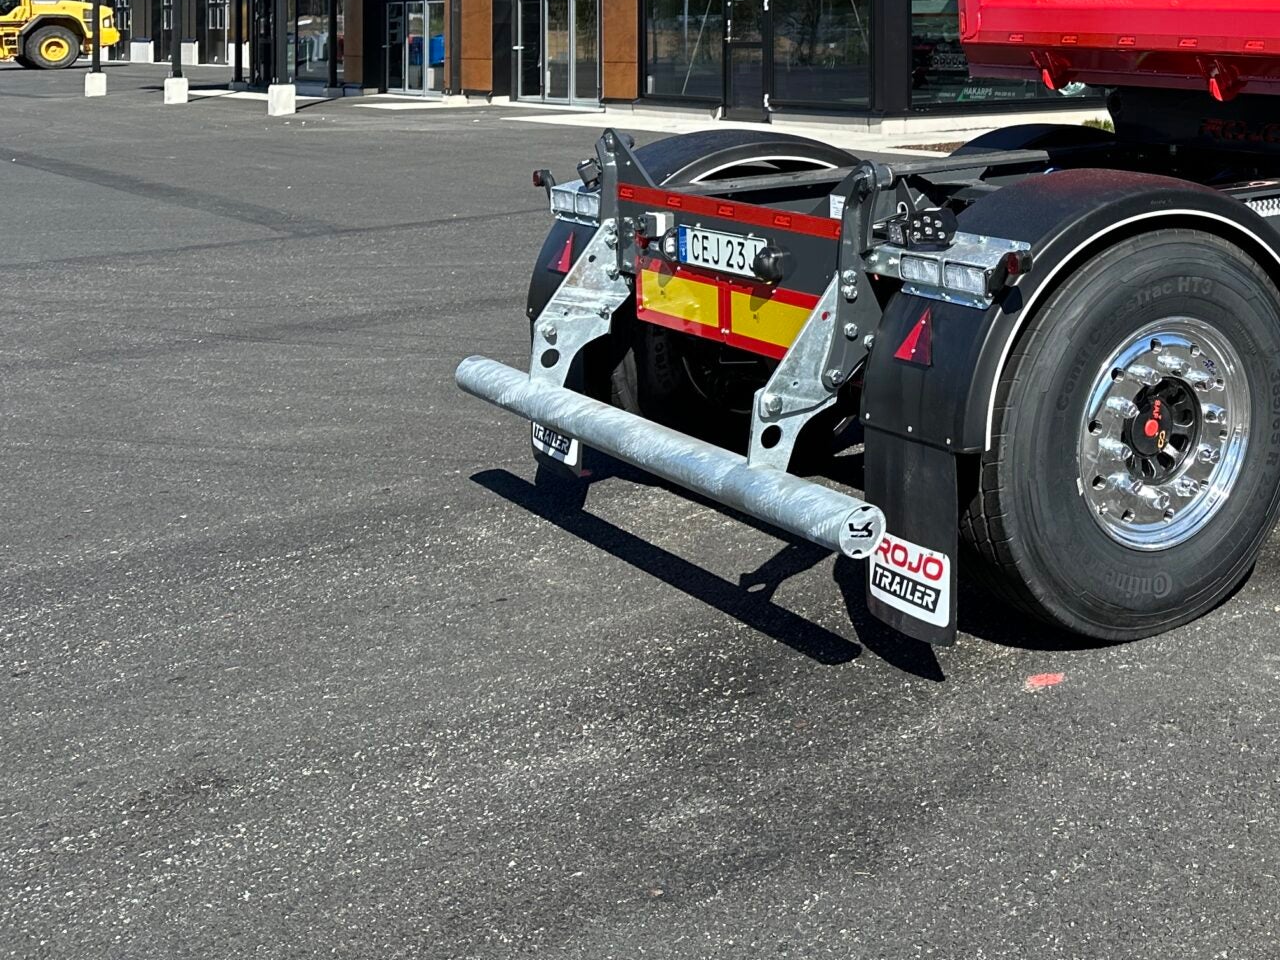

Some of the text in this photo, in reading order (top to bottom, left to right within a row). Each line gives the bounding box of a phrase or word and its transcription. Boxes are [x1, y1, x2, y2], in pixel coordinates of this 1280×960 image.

[692, 234, 720, 265] CEJ
[1177, 275, 1213, 295] HT3
[535, 424, 570, 454] TRAILER
[875, 538, 943, 581] ROJO
[875, 567, 936, 610] TRAILER
